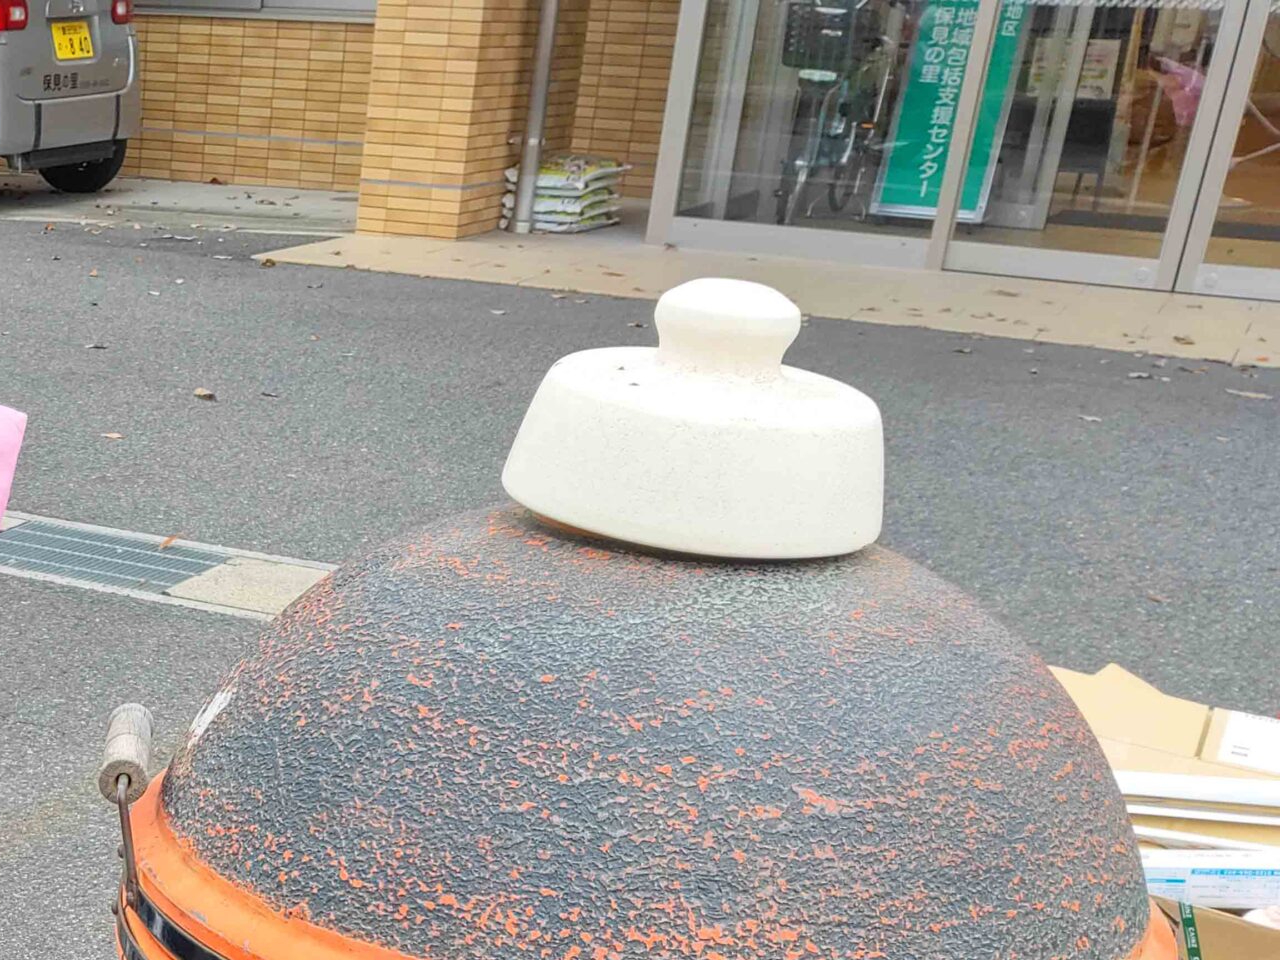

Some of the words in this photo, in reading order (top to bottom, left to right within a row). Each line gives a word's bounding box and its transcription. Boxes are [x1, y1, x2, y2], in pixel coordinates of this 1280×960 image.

[919, 7, 955, 84] 保見の里
[43, 72, 78, 92] 保見の里
